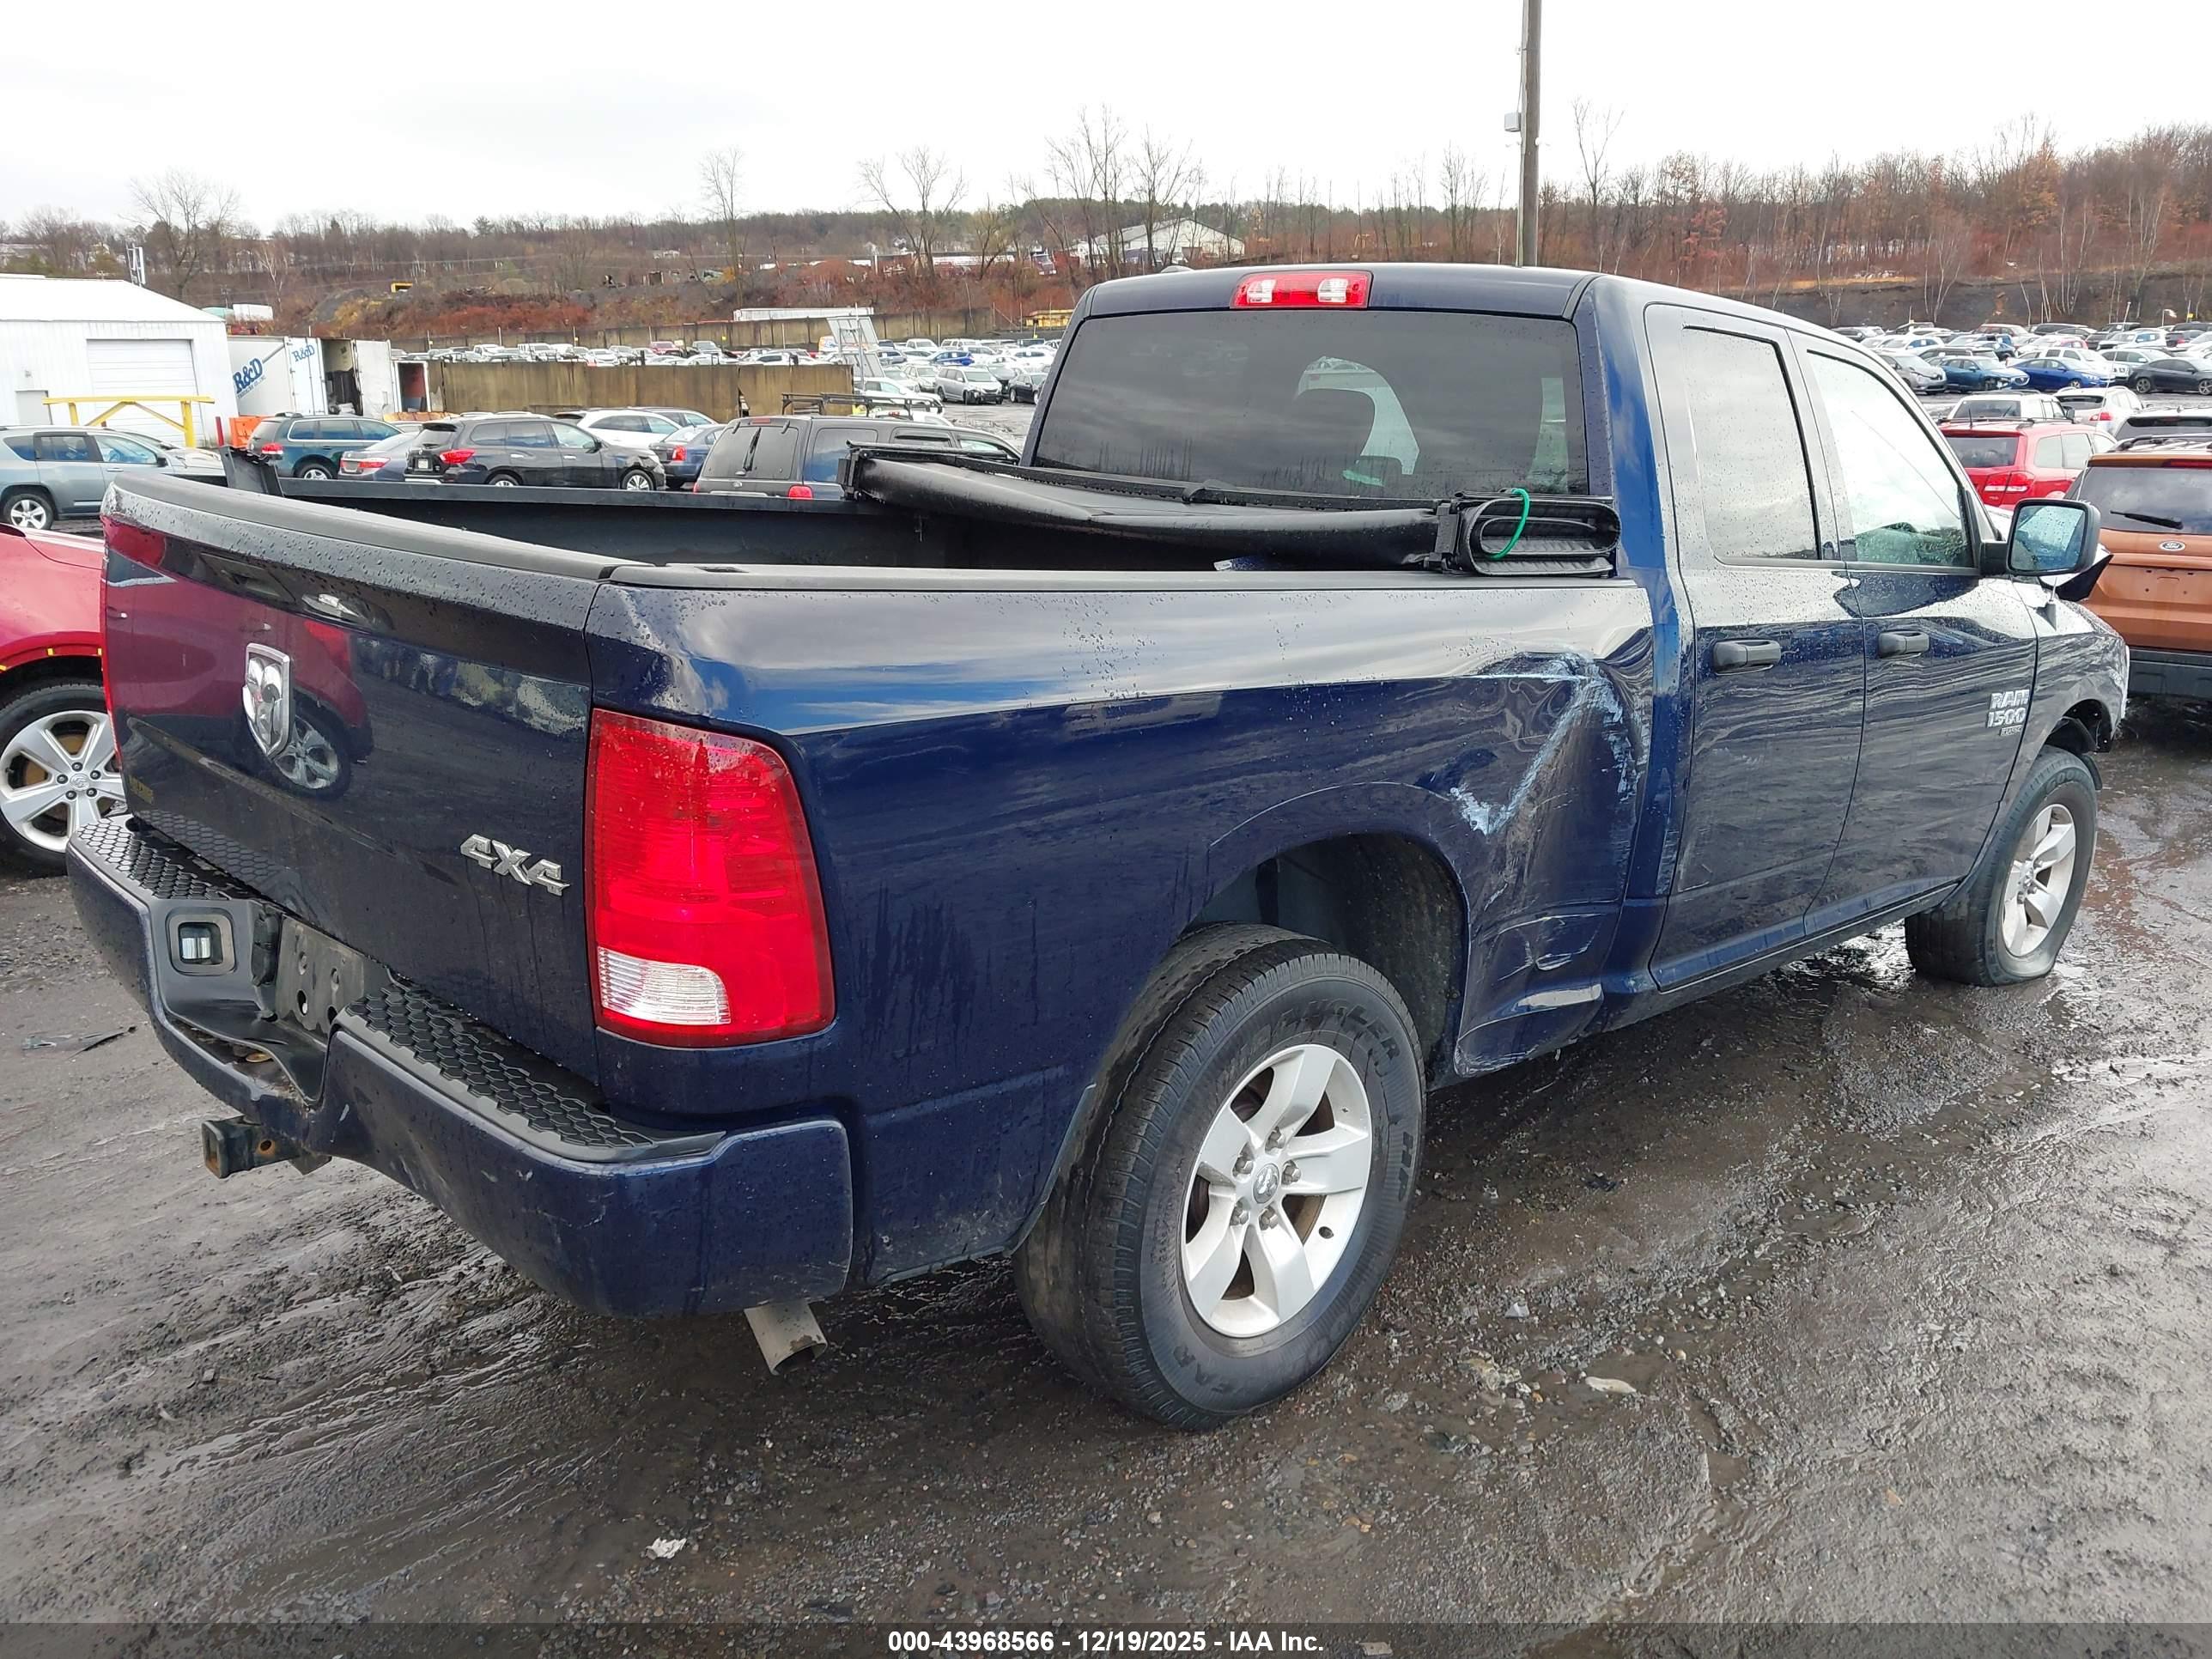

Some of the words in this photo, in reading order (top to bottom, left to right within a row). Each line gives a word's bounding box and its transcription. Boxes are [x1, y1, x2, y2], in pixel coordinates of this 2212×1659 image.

[292, 344, 315, 362] R&D
[233, 357, 263, 394] R&D
[1990, 689, 2030, 709] RAM
[1987, 707, 2027, 728] 1500
[460, 833, 571, 896] 4X4
